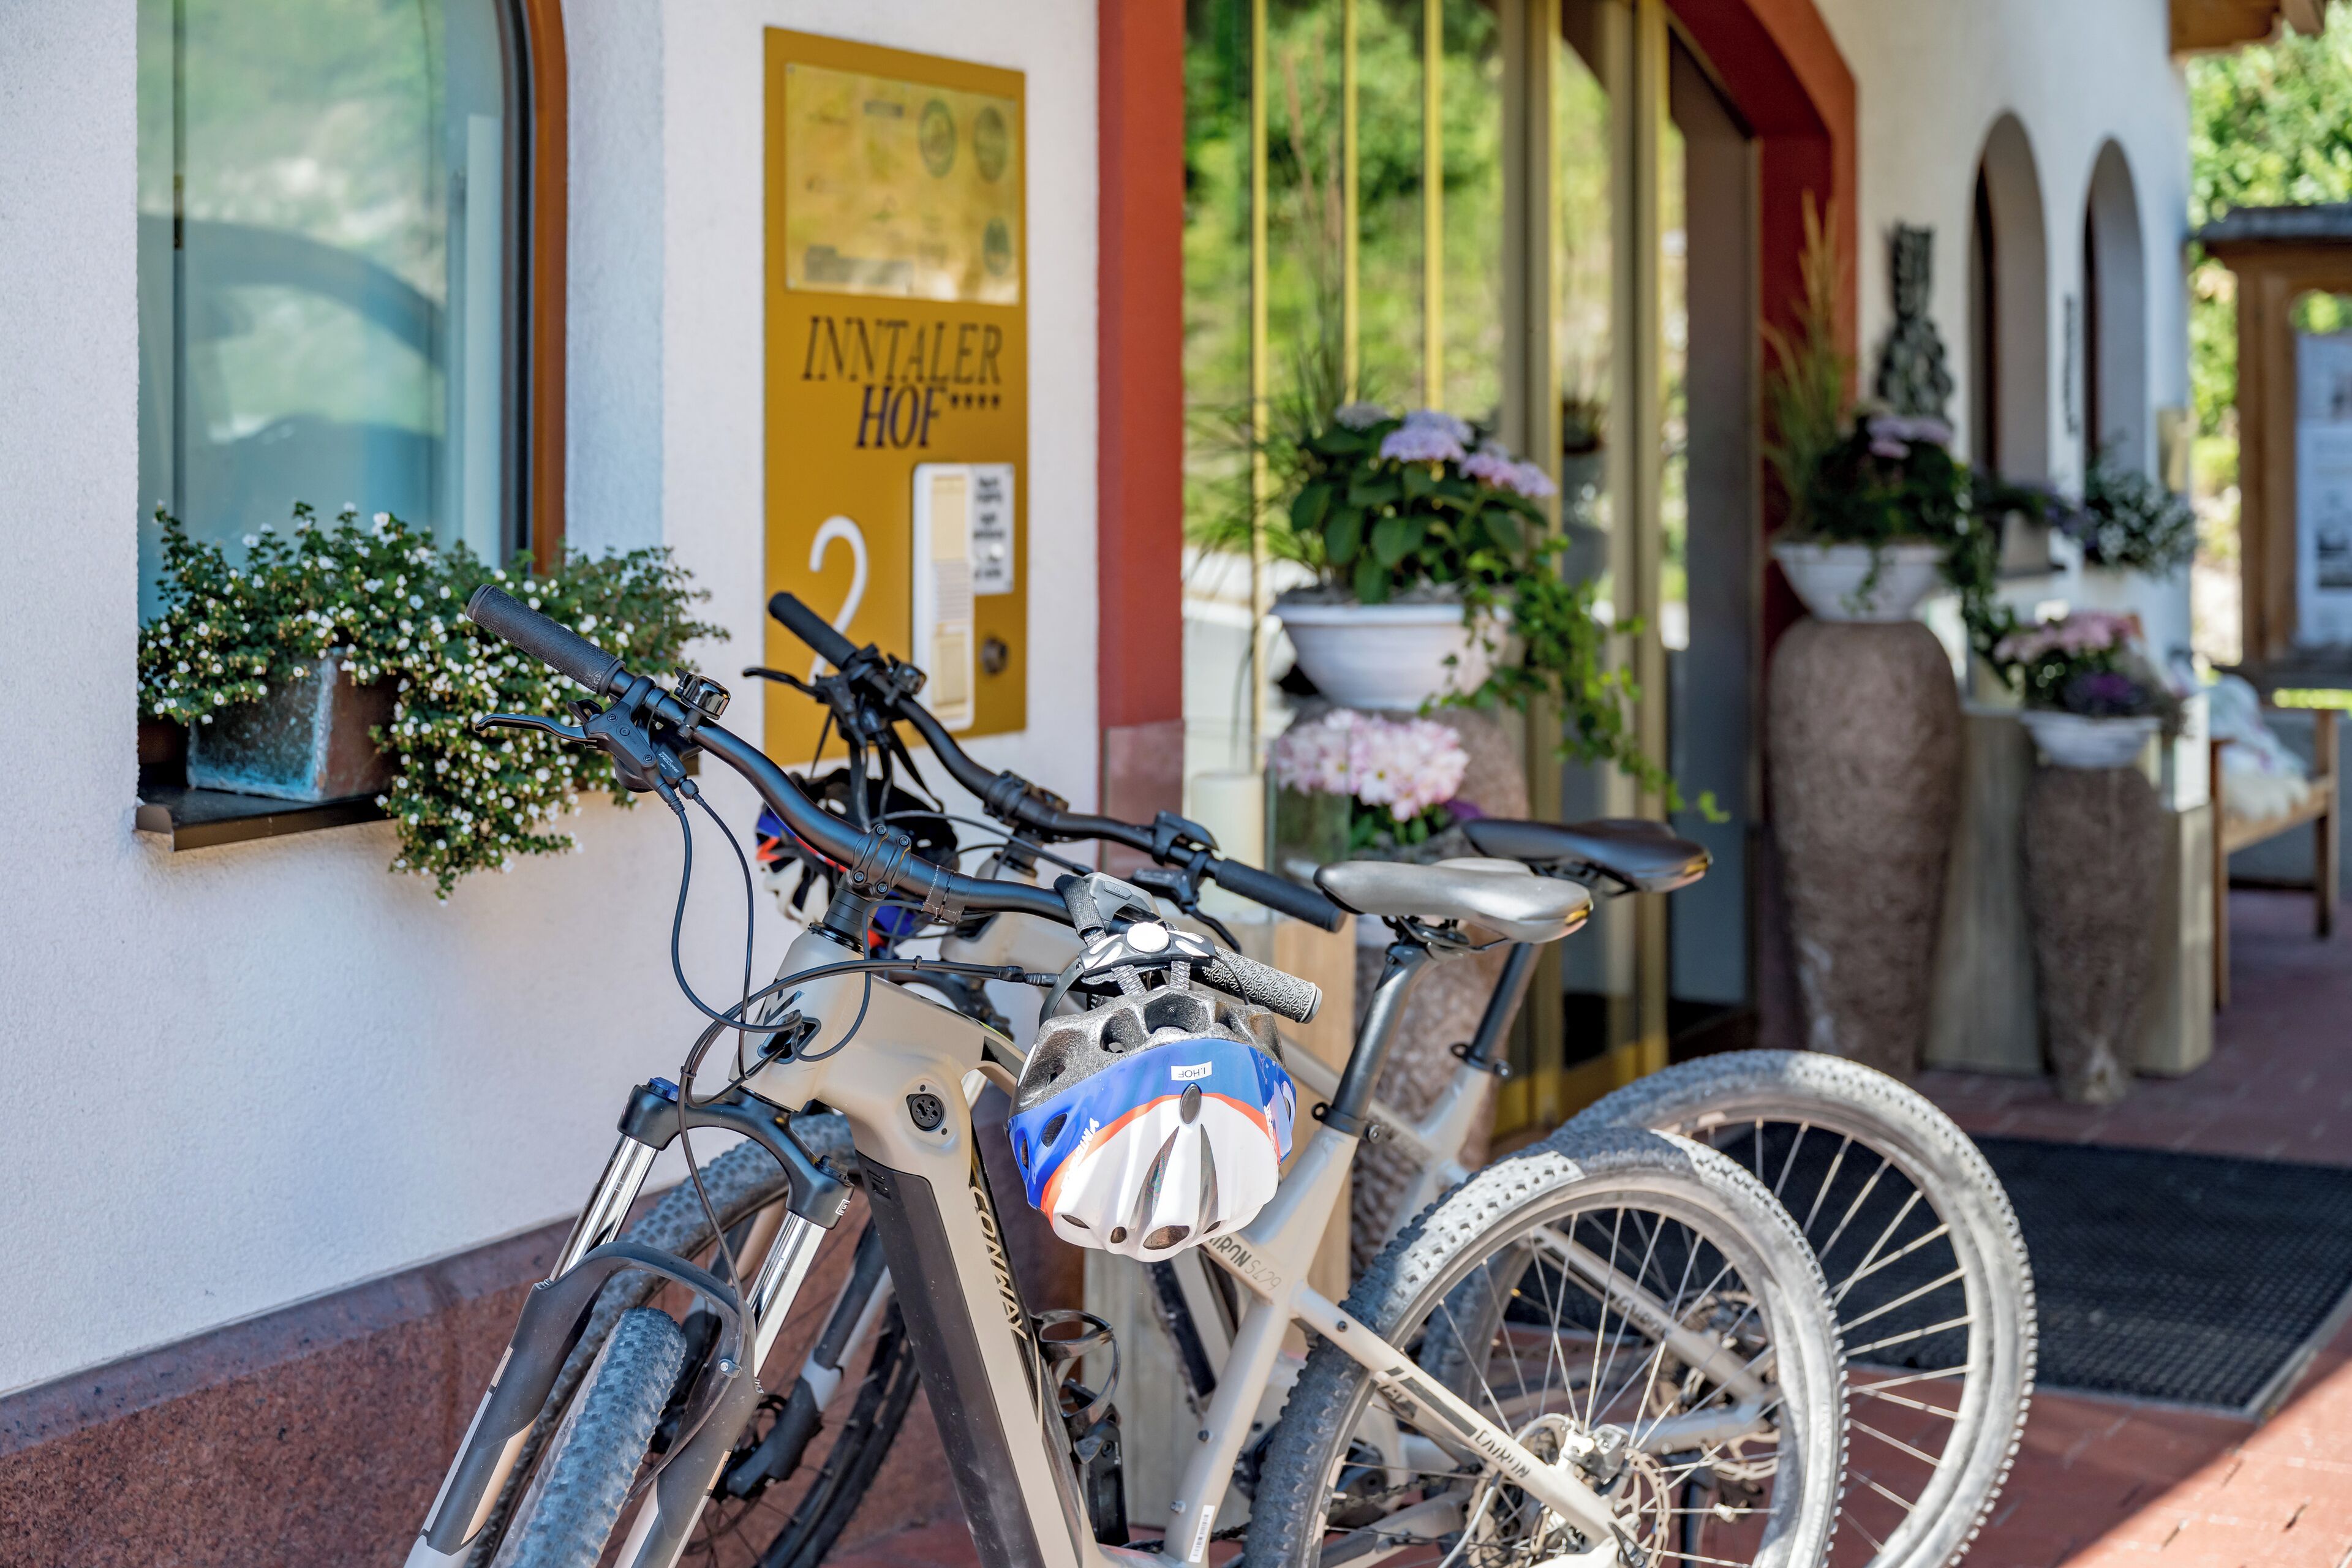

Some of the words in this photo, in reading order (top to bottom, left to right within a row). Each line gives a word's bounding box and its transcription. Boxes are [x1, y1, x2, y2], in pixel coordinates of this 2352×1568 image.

[802, 315, 1003, 385] INNTALER
[855, 383, 948, 450] HOF
[658, 753, 680, 773] DEORE
[1178, 1067, 1205, 1077] I.HOF
[970, 1186, 1028, 1341] CONWAY
